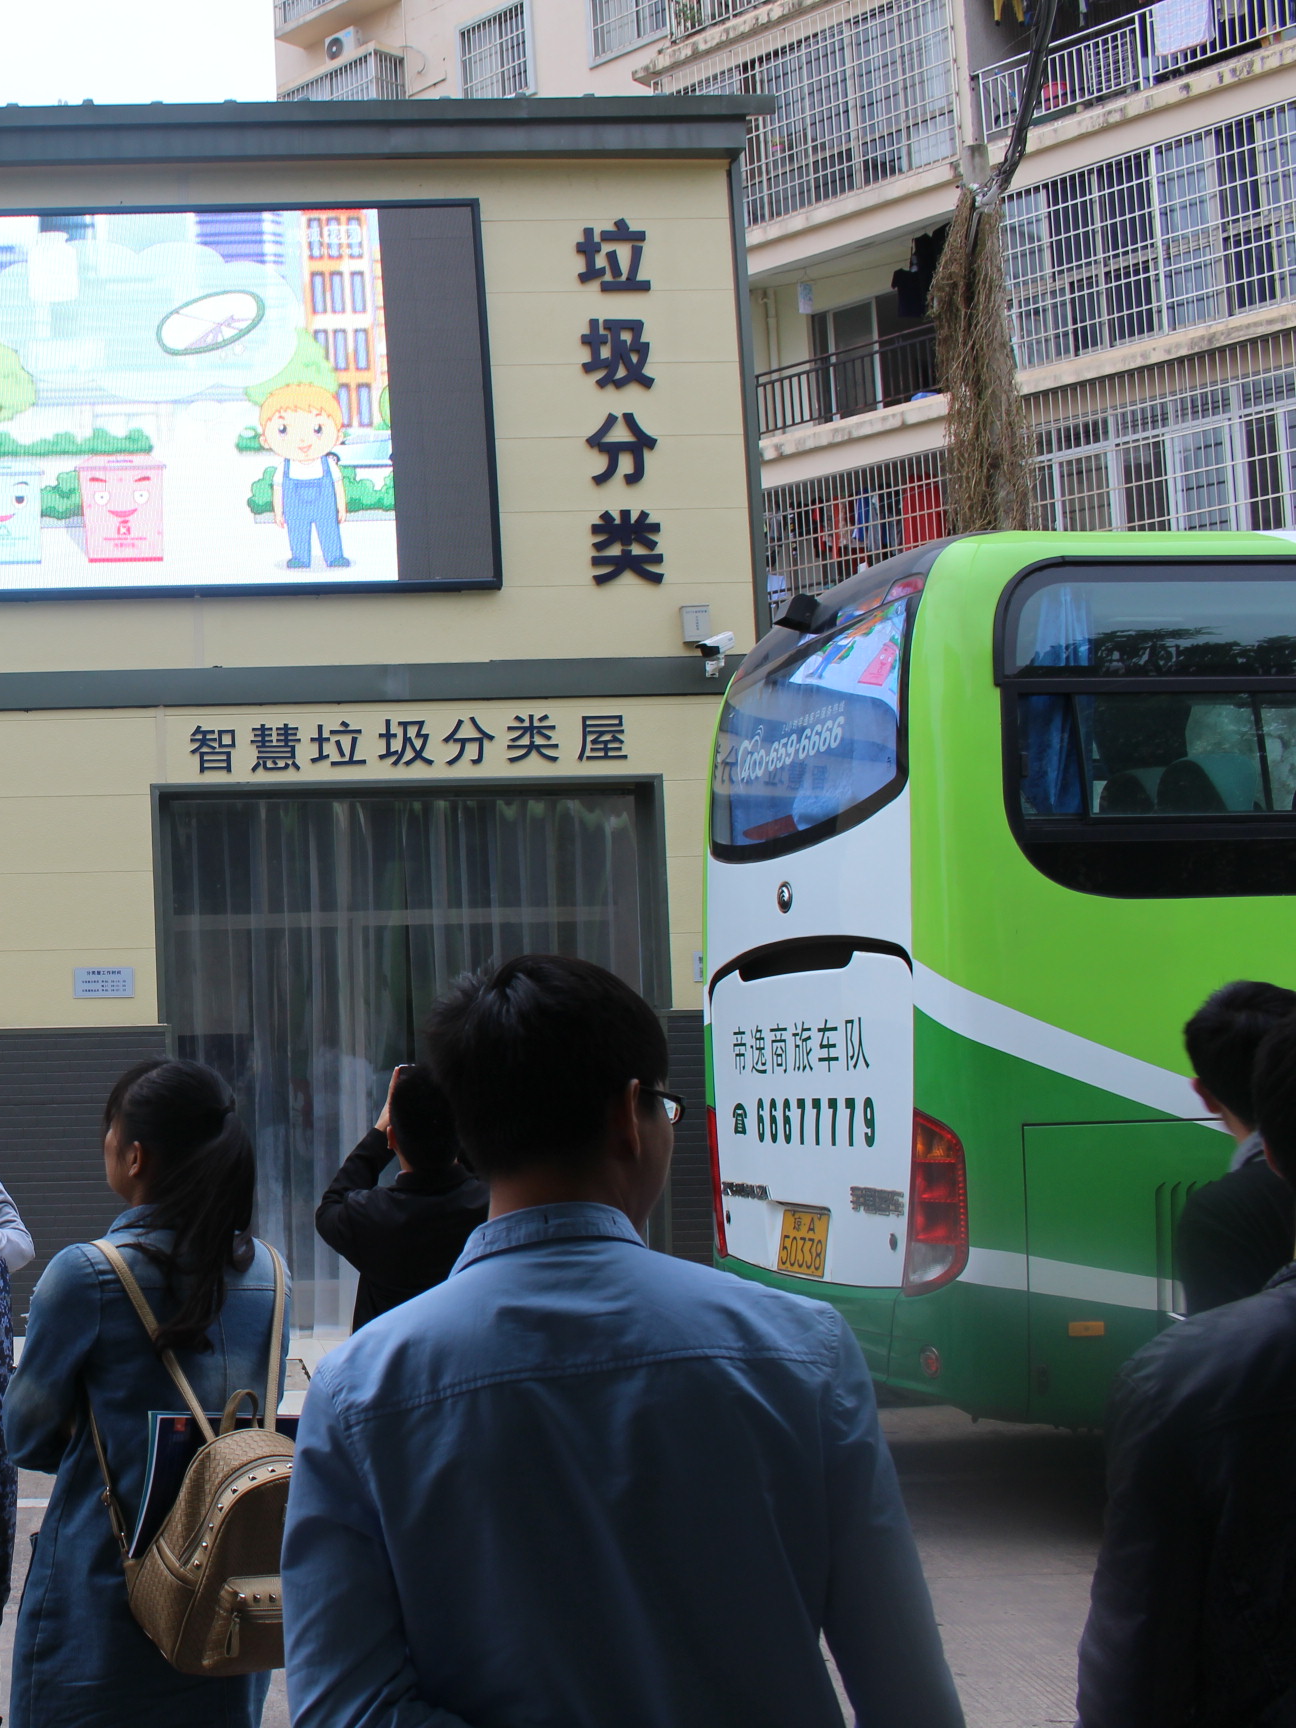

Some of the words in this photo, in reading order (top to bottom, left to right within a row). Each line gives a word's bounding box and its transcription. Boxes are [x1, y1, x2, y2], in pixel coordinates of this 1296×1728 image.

[576, 217, 665, 585] 垃圾分类
[189, 713, 629, 774] 智慧垃圾分类屋
[732, 1016, 870, 1075] 帝逸商旅车队
[757, 1097, 876, 1148] 66677779
[780, 1234, 823, 1272] 50338
